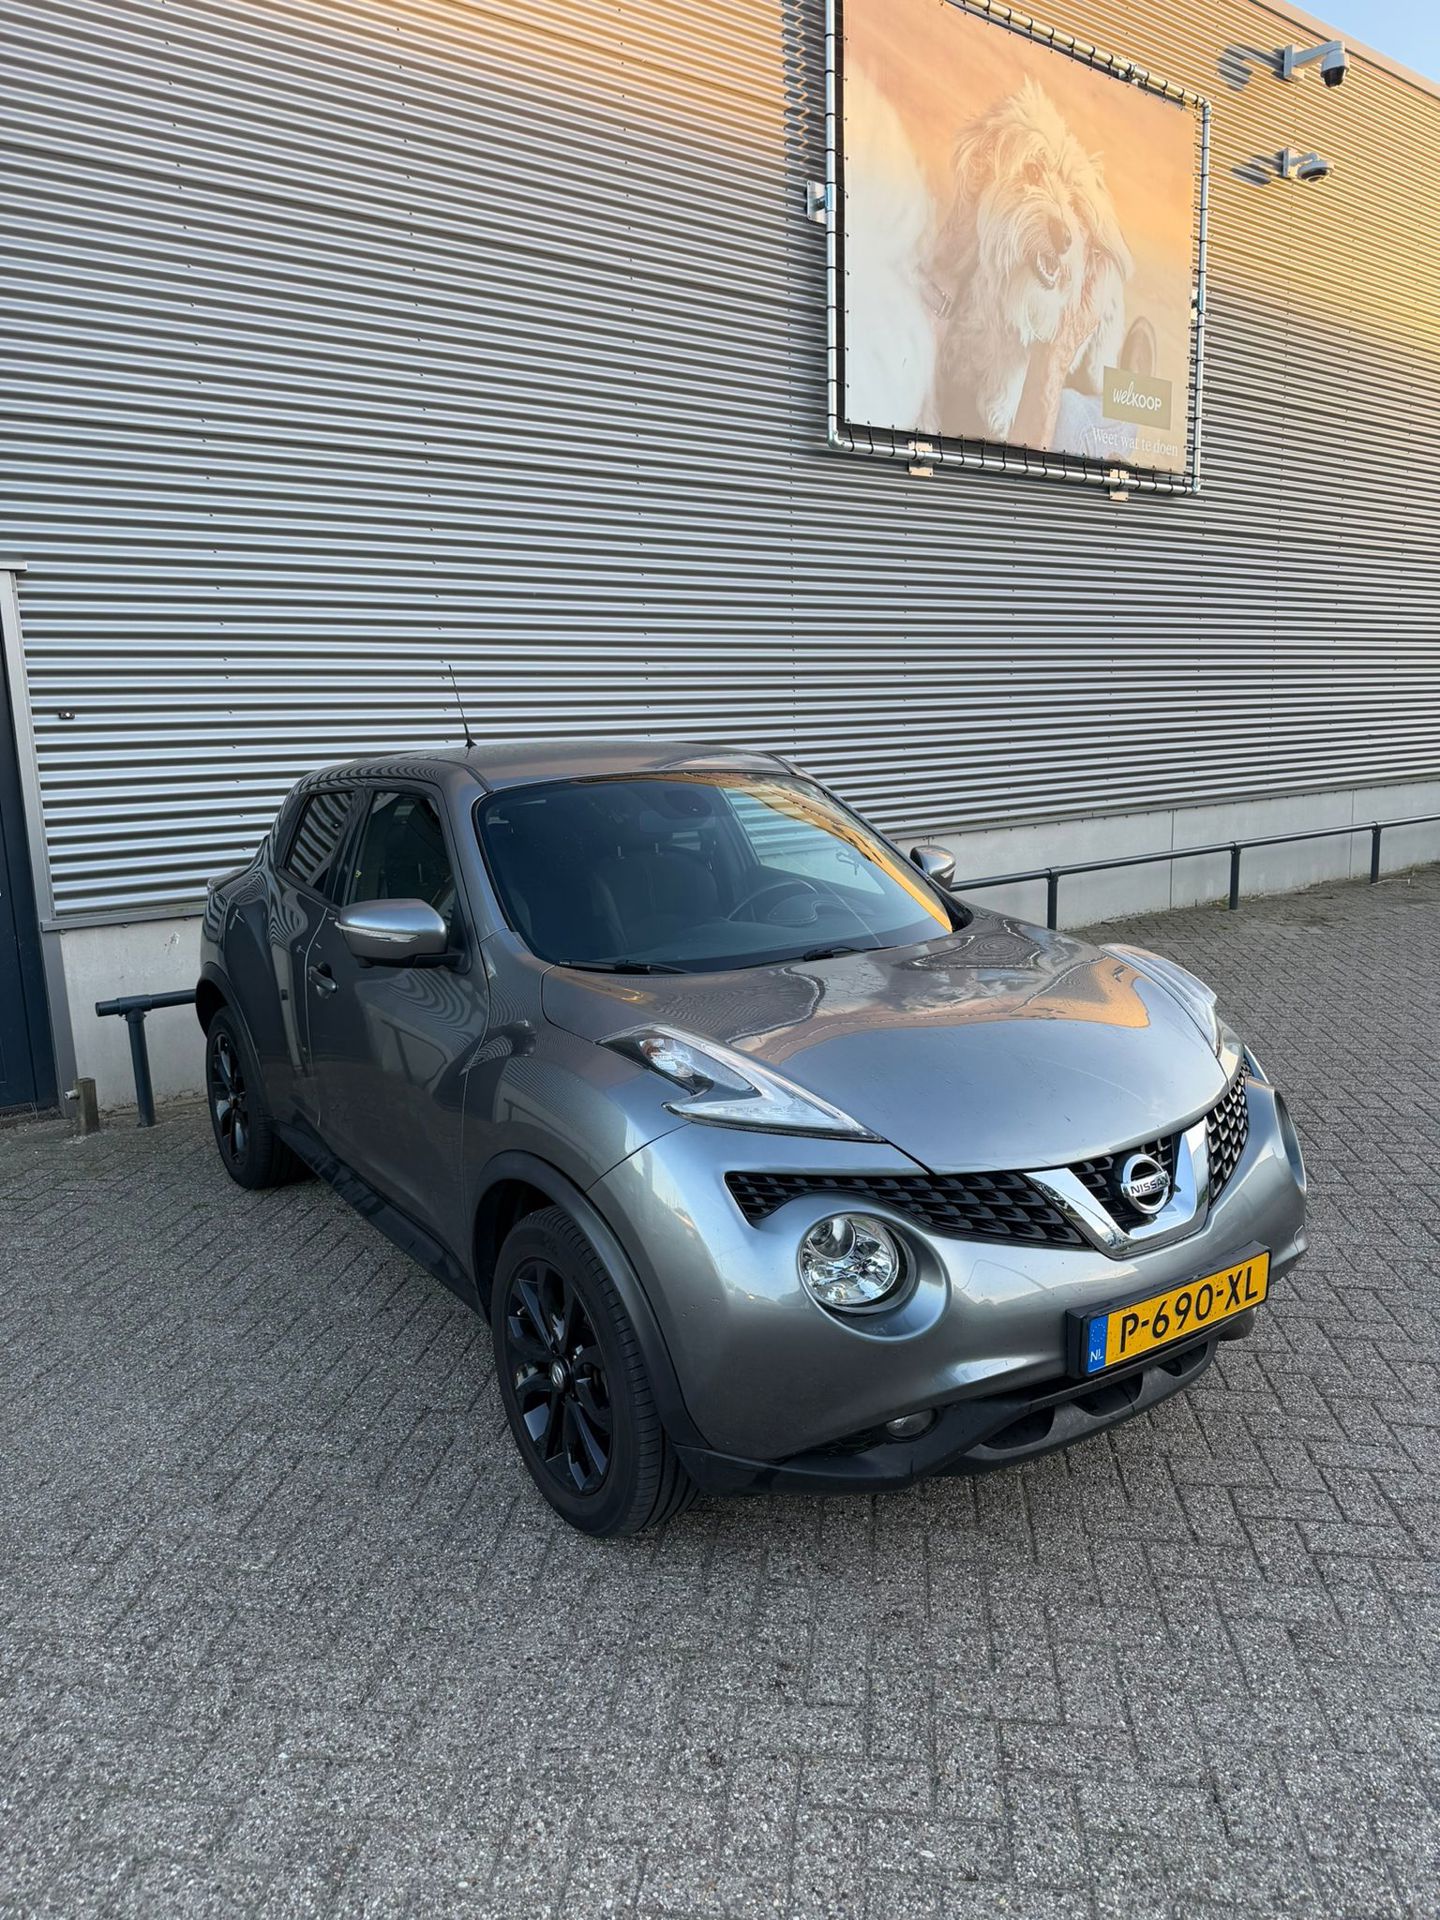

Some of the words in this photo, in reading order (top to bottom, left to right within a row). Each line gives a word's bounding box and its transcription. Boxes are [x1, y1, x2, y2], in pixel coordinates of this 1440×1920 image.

[1092, 427, 1118, 446] Weet
[1121, 435, 1139, 450] wat
[1141, 438, 1153, 451] te
[1153, 439, 1178, 457] doen
[1130, 1174, 1169, 1195] NISSAN
[1120, 1266, 1258, 1353] P-690-XL
[1089, 1348, 1104, 1363] NL
